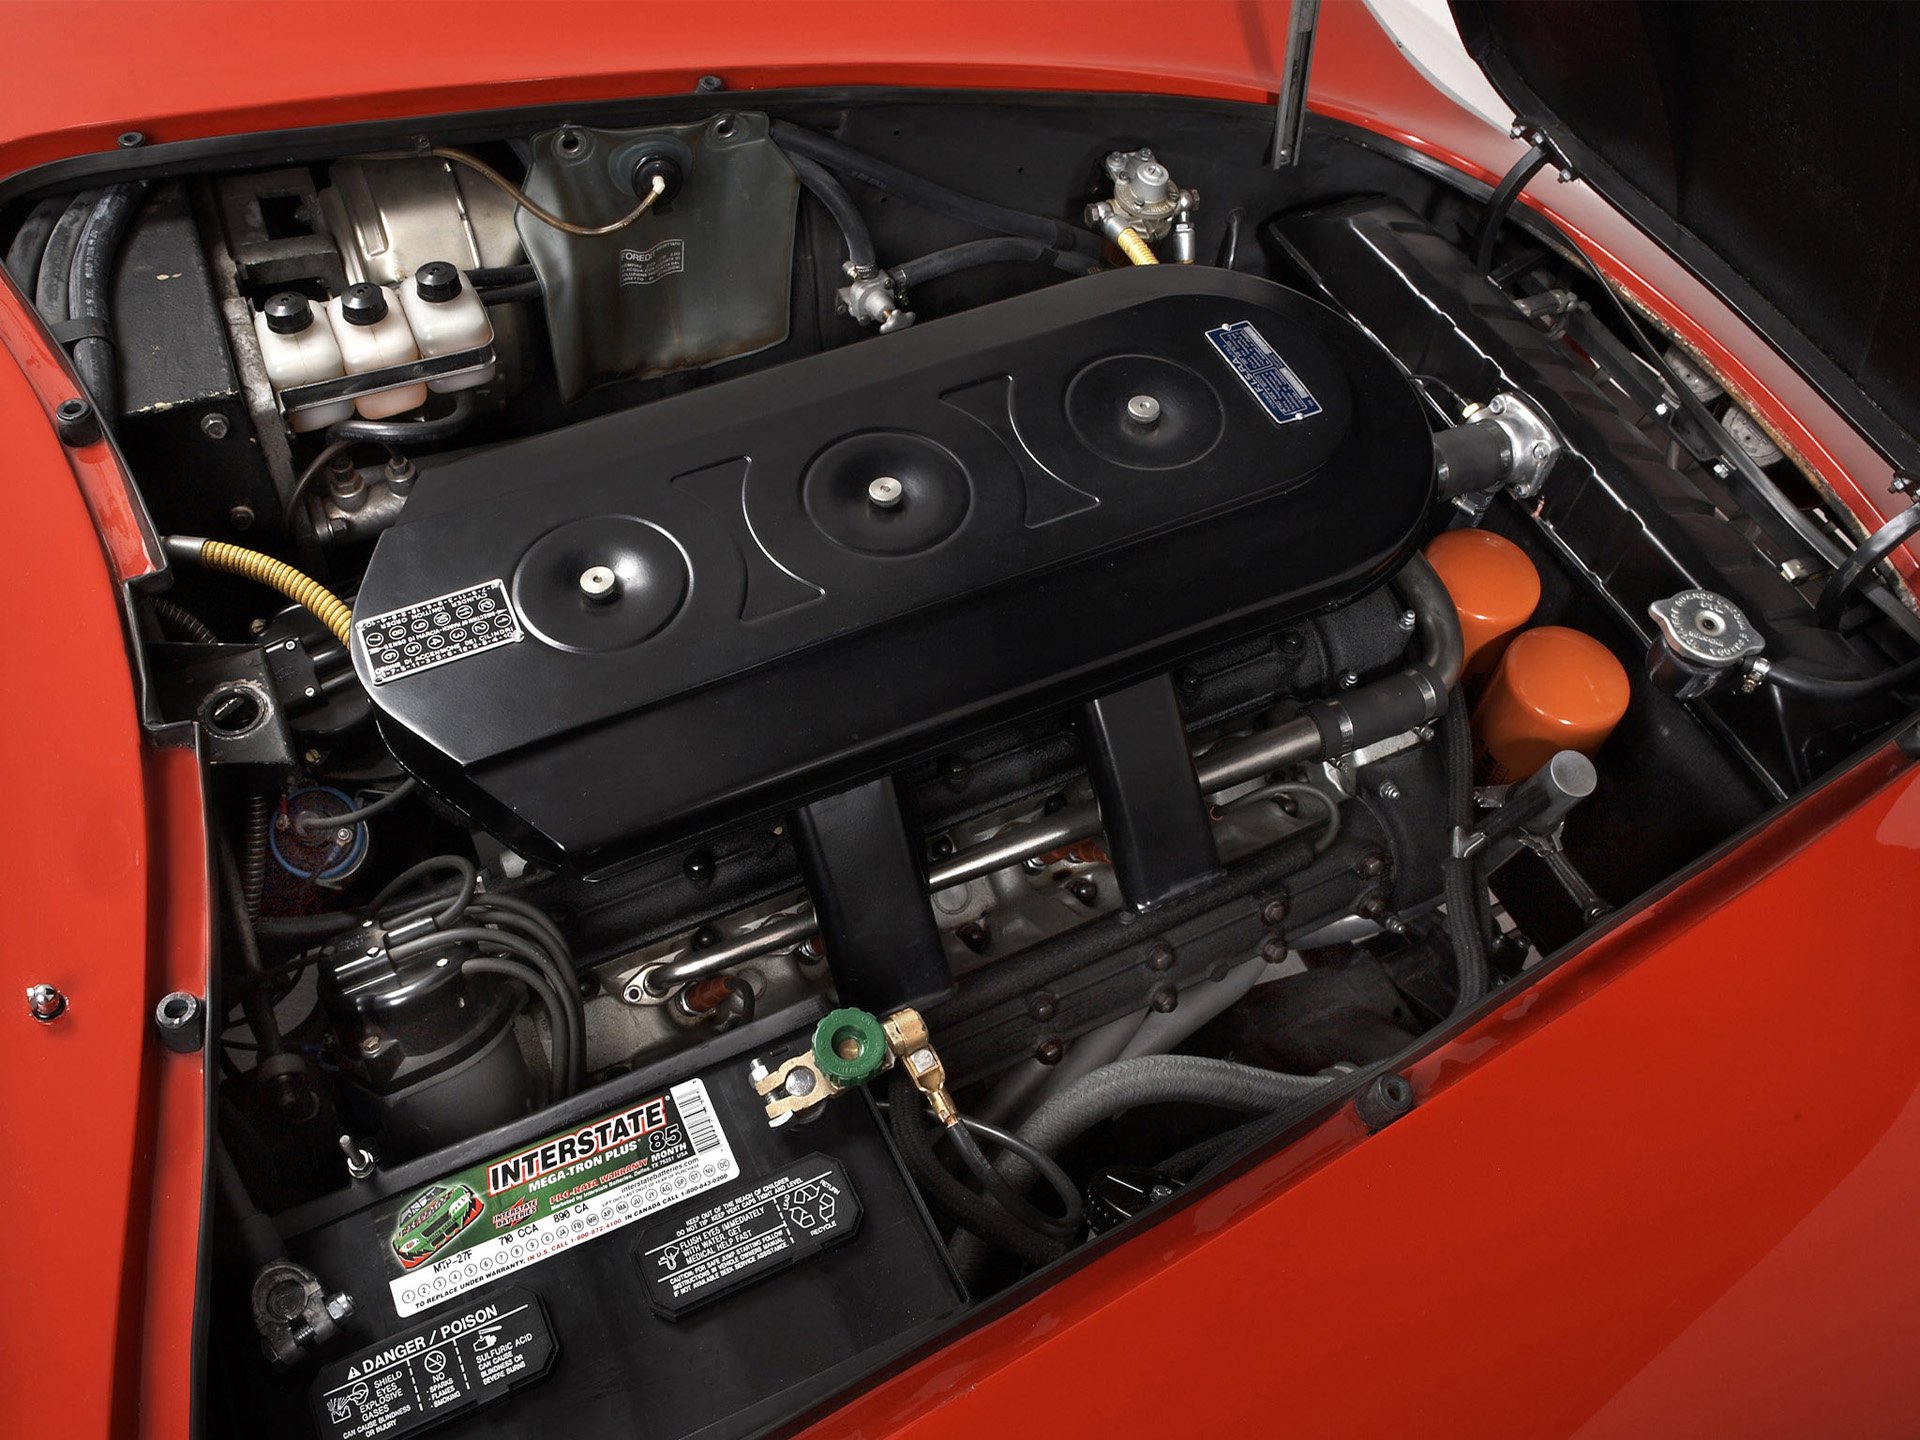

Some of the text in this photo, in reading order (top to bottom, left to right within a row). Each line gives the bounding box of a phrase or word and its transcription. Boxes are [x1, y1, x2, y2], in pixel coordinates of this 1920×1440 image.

[489, 1100, 664, 1193] INTERSTATE
[648, 1123, 682, 1153] 85
[651, 1142, 687, 1162] MONTH
[528, 1140, 638, 1193] MEGA-TRON PLUS
[622, 1158, 698, 1193] interstatebatteries.com
[549, 1157, 648, 1205] PRO-RATA WARRANTY
[819, 1178, 841, 1197] RETURN
[493, 1200, 538, 1222] INTERSTATE
[553, 1203, 589, 1223] 890 CA
[686, 1216, 700, 1226] KEEP
[701, 1210, 713, 1219] OUT
[714, 1206, 721, 1214] OF
[722, 1200, 734, 1210] THE
[735, 1193, 754, 1204] REACH
[763, 1177, 789, 1192] CHILDREN
[686, 1223, 698, 1233] NOT
[699, 1219, 708, 1227] TIP
[711, 1211, 725, 1221] KEEP
[726, 1204, 740, 1214] VENT
[741, 1198, 756, 1208] CAPS
[757, 1190, 773, 1201] TIGHT
[774, 1185, 786, 1194] AND
[786, 1178, 803, 1188] LEVEL
[496, 1207, 537, 1228] BATTERIES
[680, 1207, 764, 1250] FLUSH EYES IMMEDIATELY
[810, 1220, 838, 1237] RECYCLE
[498, 1224, 539, 1246] 710 CCA
[682, 1244, 701, 1257] WITH
[728, 1225, 741, 1237] GET
[686, 1229, 752, 1264] MEDICAL HELP FAST
[426, 1287, 457, 1304] REPLACE
[460, 1276, 484, 1290] UNDER
[486, 1259, 525, 1278] WARRANTY,
[551, 1241, 568, 1251] CALL
[634, 1202, 661, 1216] CANADA
[662, 1194, 679, 1204] CALL
[694, 1264, 706, 1273] FOR
[706, 1258, 720, 1268] SAFE
[722, 1251, 735, 1262] JUMP
[736, 1240, 762, 1255] STARTING
[762, 1230, 783, 1243] FOLLOW
[433, 1250, 472, 1273] MTP-27F
[673, 1270, 710, 1290] INSTRUCTIONS
[718, 1256, 739, 1269] VEHICLE
[740, 1246, 762, 1260] OWNERS
[680, 1285, 691, 1294] NOT
[693, 1272, 719, 1289] AVAILABLE
[720, 1266, 734, 1276] SEEK
[734, 1256, 756, 1270] SERVICE
[363, 1337, 426, 1372] DANGER
[441, 1305, 497, 1338] POISON
[476, 1333, 532, 1364] SULFURIC ACID
[478, 1351, 513, 1371] CAN CAUSE
[480, 1354, 524, 1378] BLINDNESS OR
[483, 1361, 526, 1385] SEVERE BURNS
[374, 1371, 402, 1388] SHIELD
[376, 1382, 397, 1397] EYES
[429, 1378, 453, 1393] SPARKS
[432, 1372, 445, 1383] NO
[360, 1388, 403, 1413] EXPLOSIVE
[431, 1385, 455, 1400] FLAMES
[434, 1391, 461, 1408] SMOKING
[343, 1405, 411, 1439] CAN CAUSE BLINDNESS
[362, 1404, 389, 1422] GASES
[365, 1419, 396, 1438] OR INJURY
